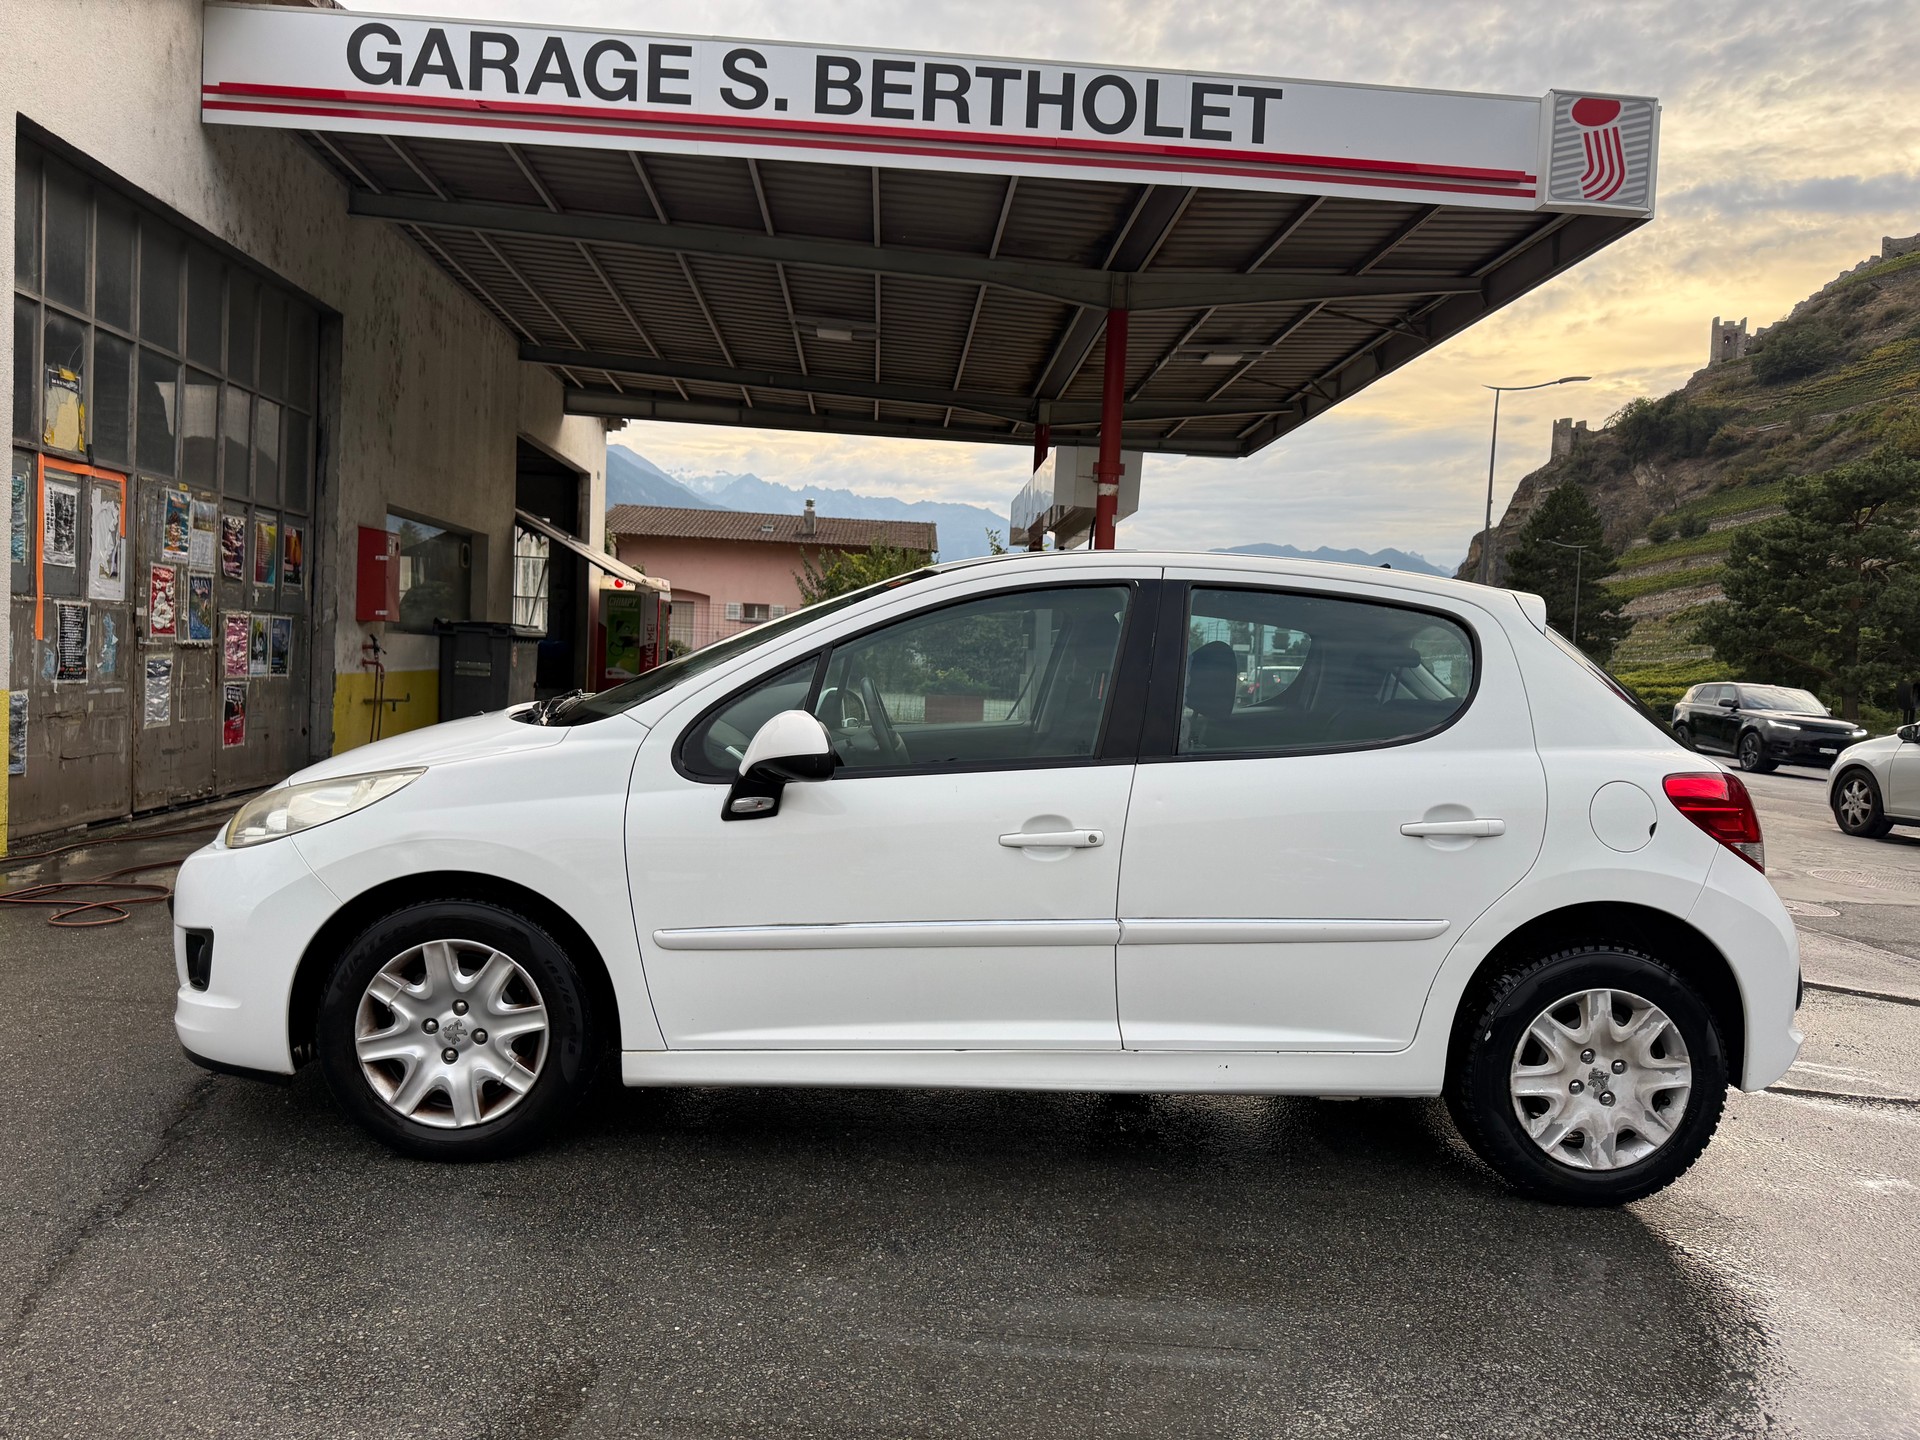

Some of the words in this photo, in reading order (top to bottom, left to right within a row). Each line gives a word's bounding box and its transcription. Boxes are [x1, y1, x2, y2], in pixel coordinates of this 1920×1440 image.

[346, 22, 693, 105] GARAGE
[719, 47, 788, 111] S.
[814, 54, 1283, 145] BERTHOLET
[608, 596, 638, 607] CHIMPY
[645, 642, 655, 667] TAKE
